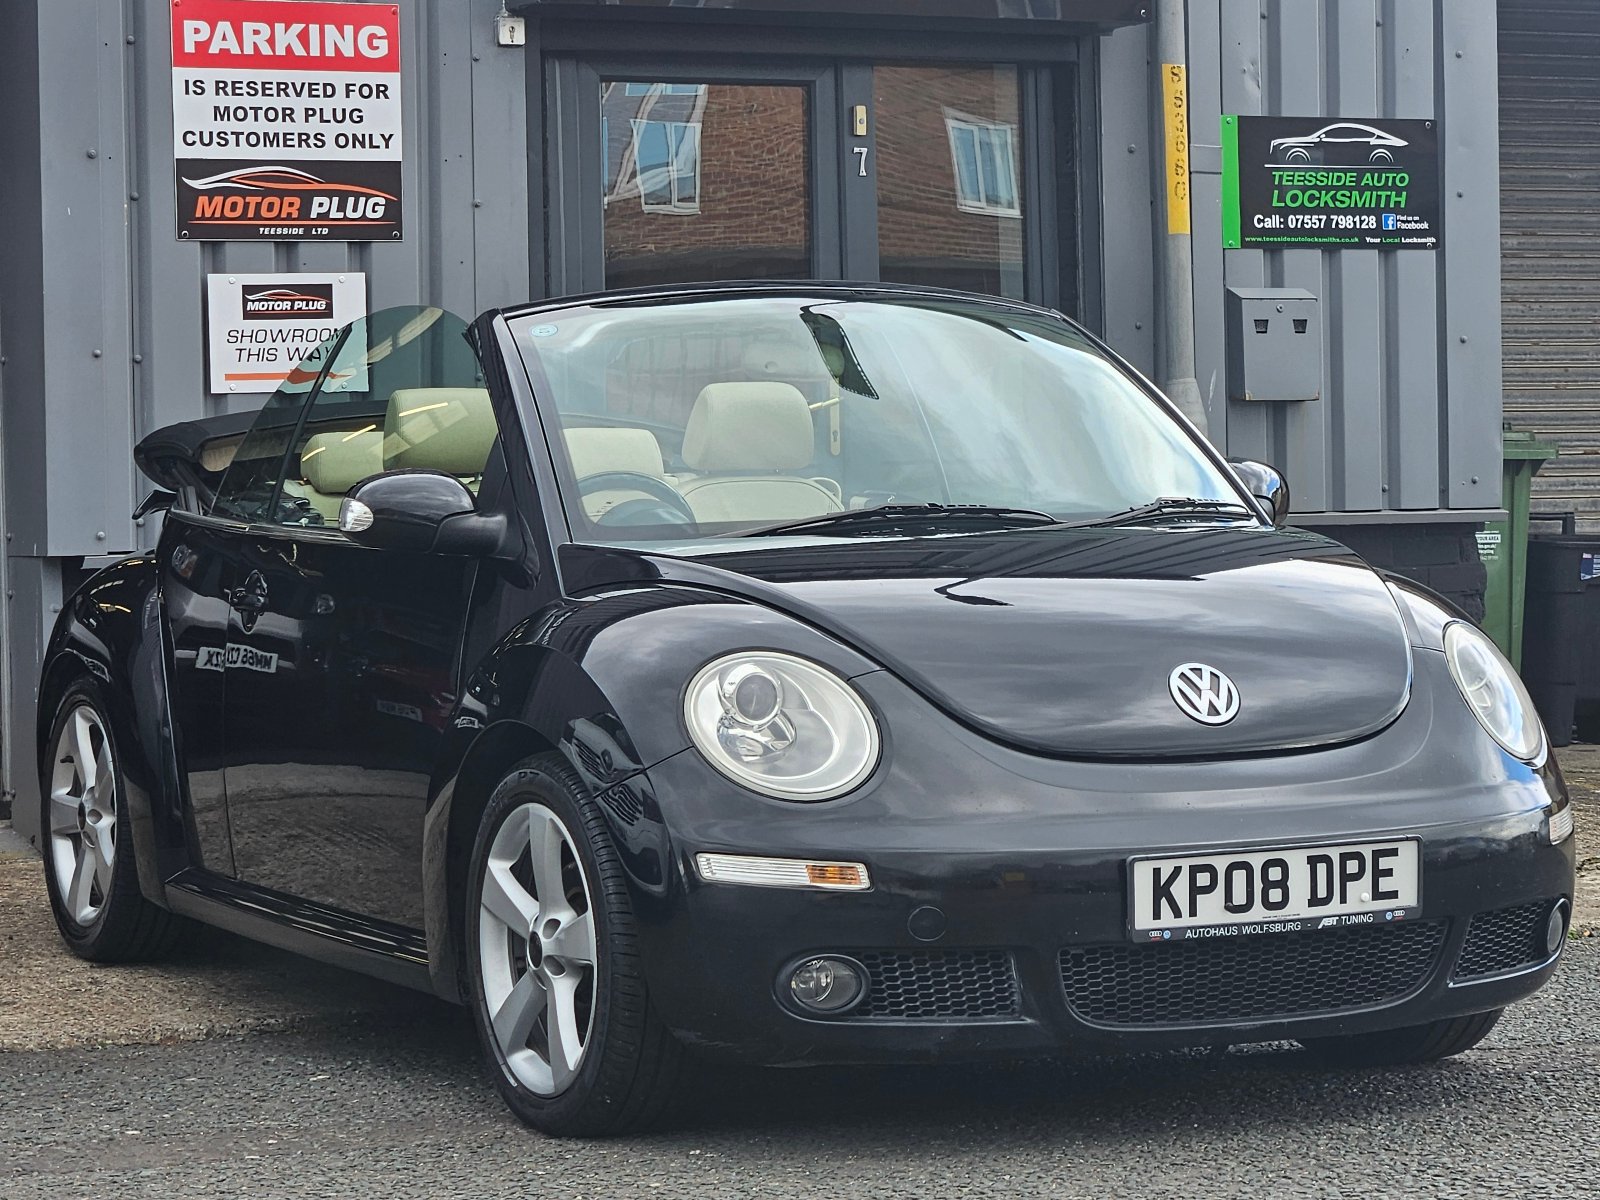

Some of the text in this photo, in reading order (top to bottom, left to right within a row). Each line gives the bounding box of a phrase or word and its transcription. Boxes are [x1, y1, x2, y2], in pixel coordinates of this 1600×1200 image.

[183, 20, 389, 58] PARKING
[184, 79, 390, 100] IS RESERVED FOR
[213, 105, 364, 124] MOTOR PLUG
[182, 130, 394, 150] CUSTOMERS ONLY
[853, 146, 868, 177] 7
[1271, 171, 1409, 187] TEESSIDE AUTO
[195, 195, 386, 220] MOTOR PLUG
[1271, 189, 1408, 208] LOCKSMITH
[1253, 214, 1377, 229] Call: 07557 798128
[1397, 221, 1430, 230] Facebook
[259, 227, 329, 236] TEESSIDE LTD
[1245, 235, 1360, 243] www.teessideautolocksmiths.co.uk
[246, 300, 327, 311] MOTOR PLUG
[235, 347, 278, 363] THIS
[1168, 662, 1241, 727] VW
[1152, 847, 1399, 920] KP08 DPE
[1185, 926, 1238, 939] AUTOHAUS
[1242, 921, 1301, 935] WOLFSBURG
[1341, 913, 1374, 925] TUNING
